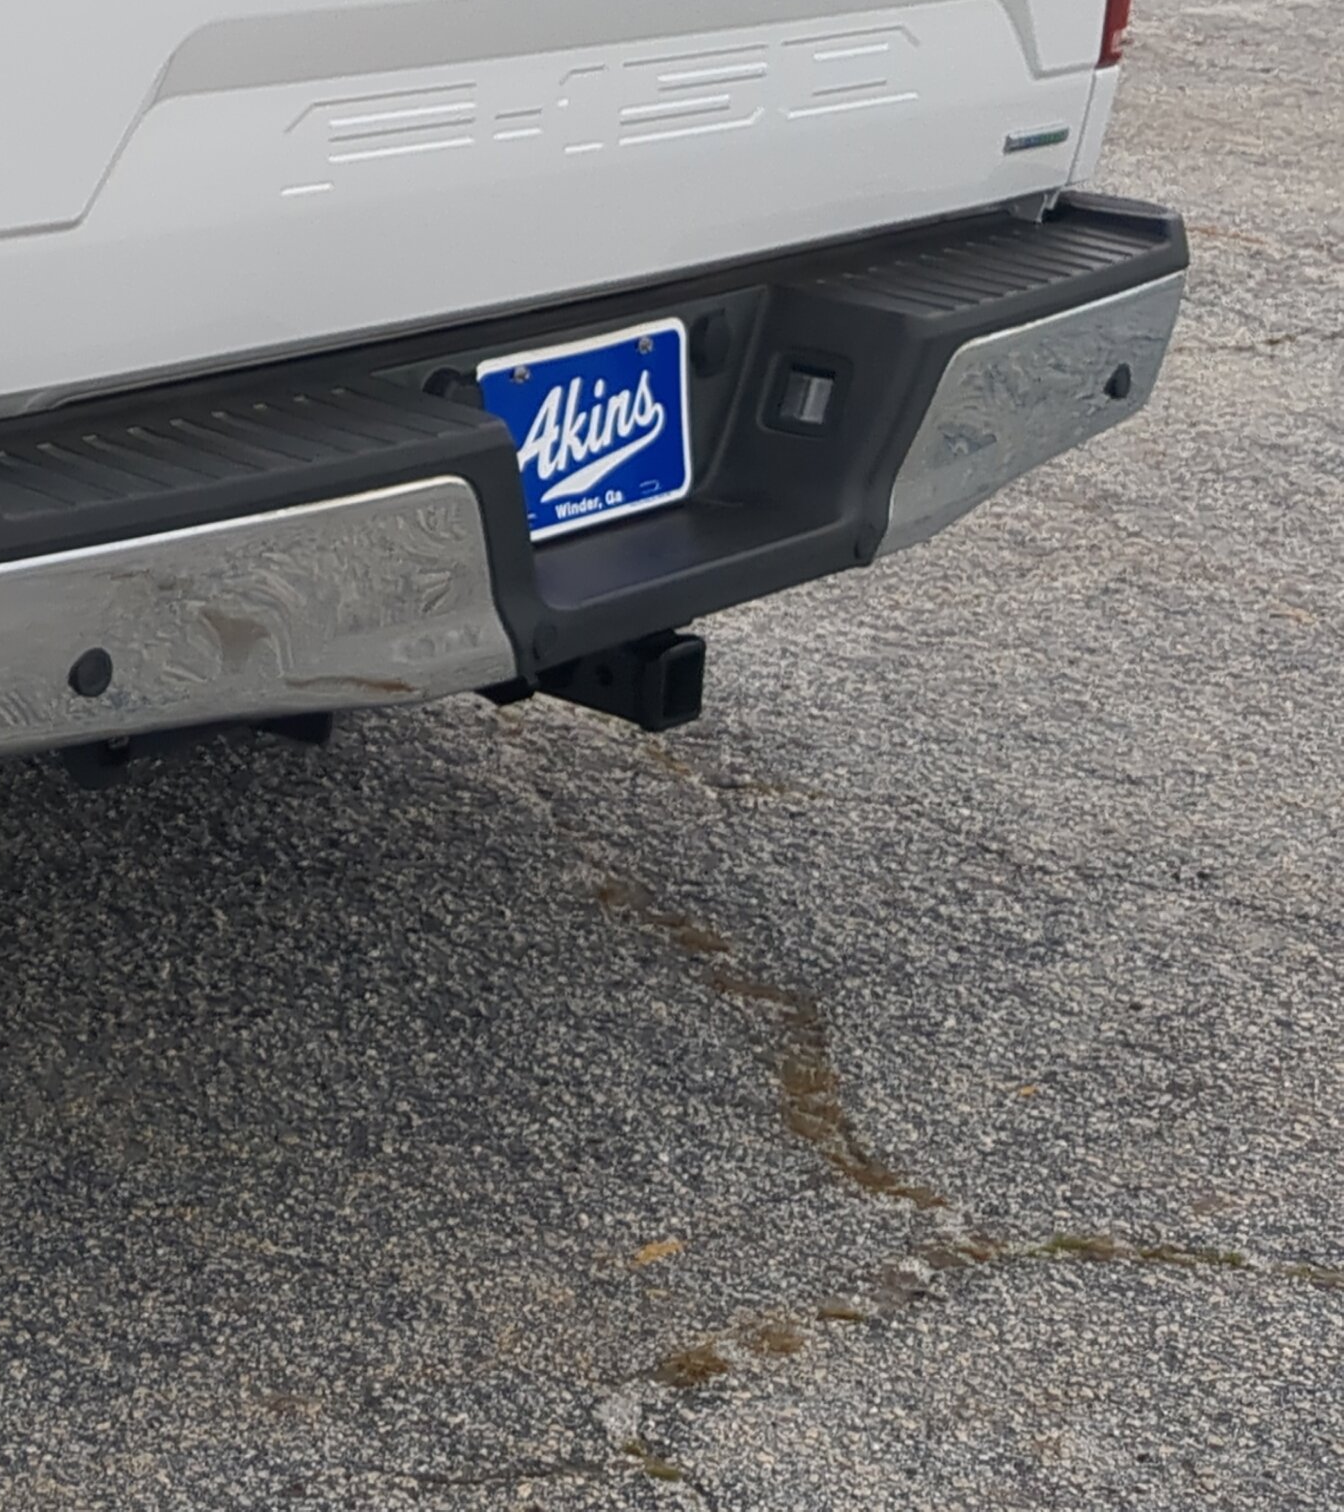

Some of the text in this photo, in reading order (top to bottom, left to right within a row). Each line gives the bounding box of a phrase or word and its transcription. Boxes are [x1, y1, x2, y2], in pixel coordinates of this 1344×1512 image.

[516, 370, 655, 480] Akins
[555, 496, 603, 519] Winder,
[605, 490, 623, 505] Ga
